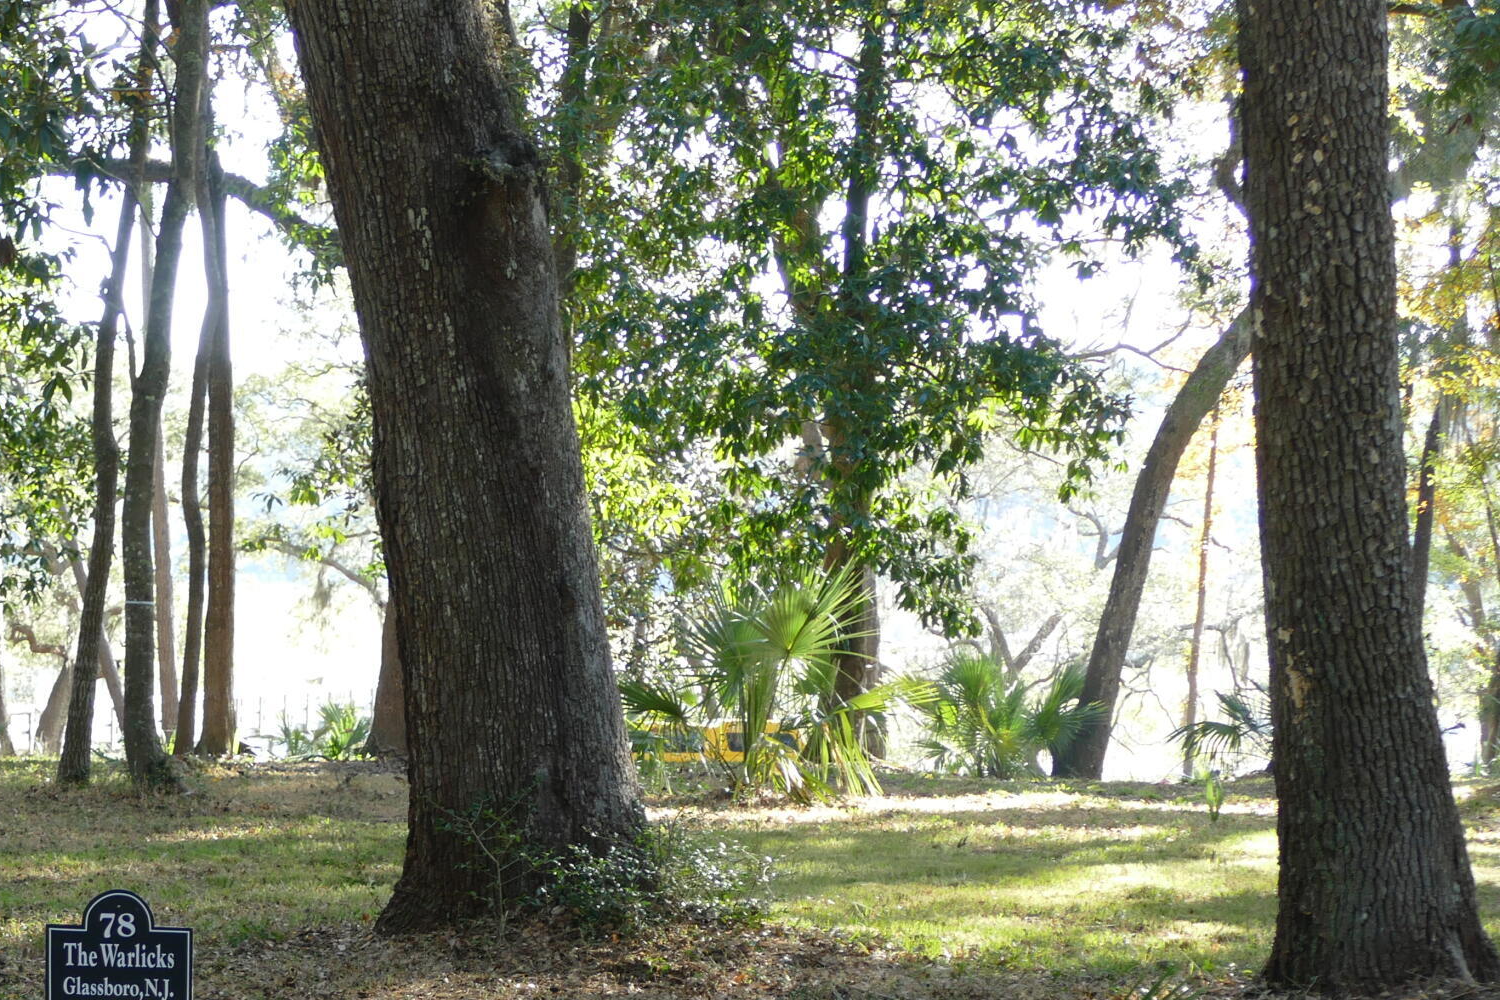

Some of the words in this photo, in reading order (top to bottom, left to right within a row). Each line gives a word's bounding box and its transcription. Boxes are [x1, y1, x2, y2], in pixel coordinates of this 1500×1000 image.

[99, 913, 136, 938] 78
[63, 942, 97, 967] The
[100, 943, 175, 969] Warlicks
